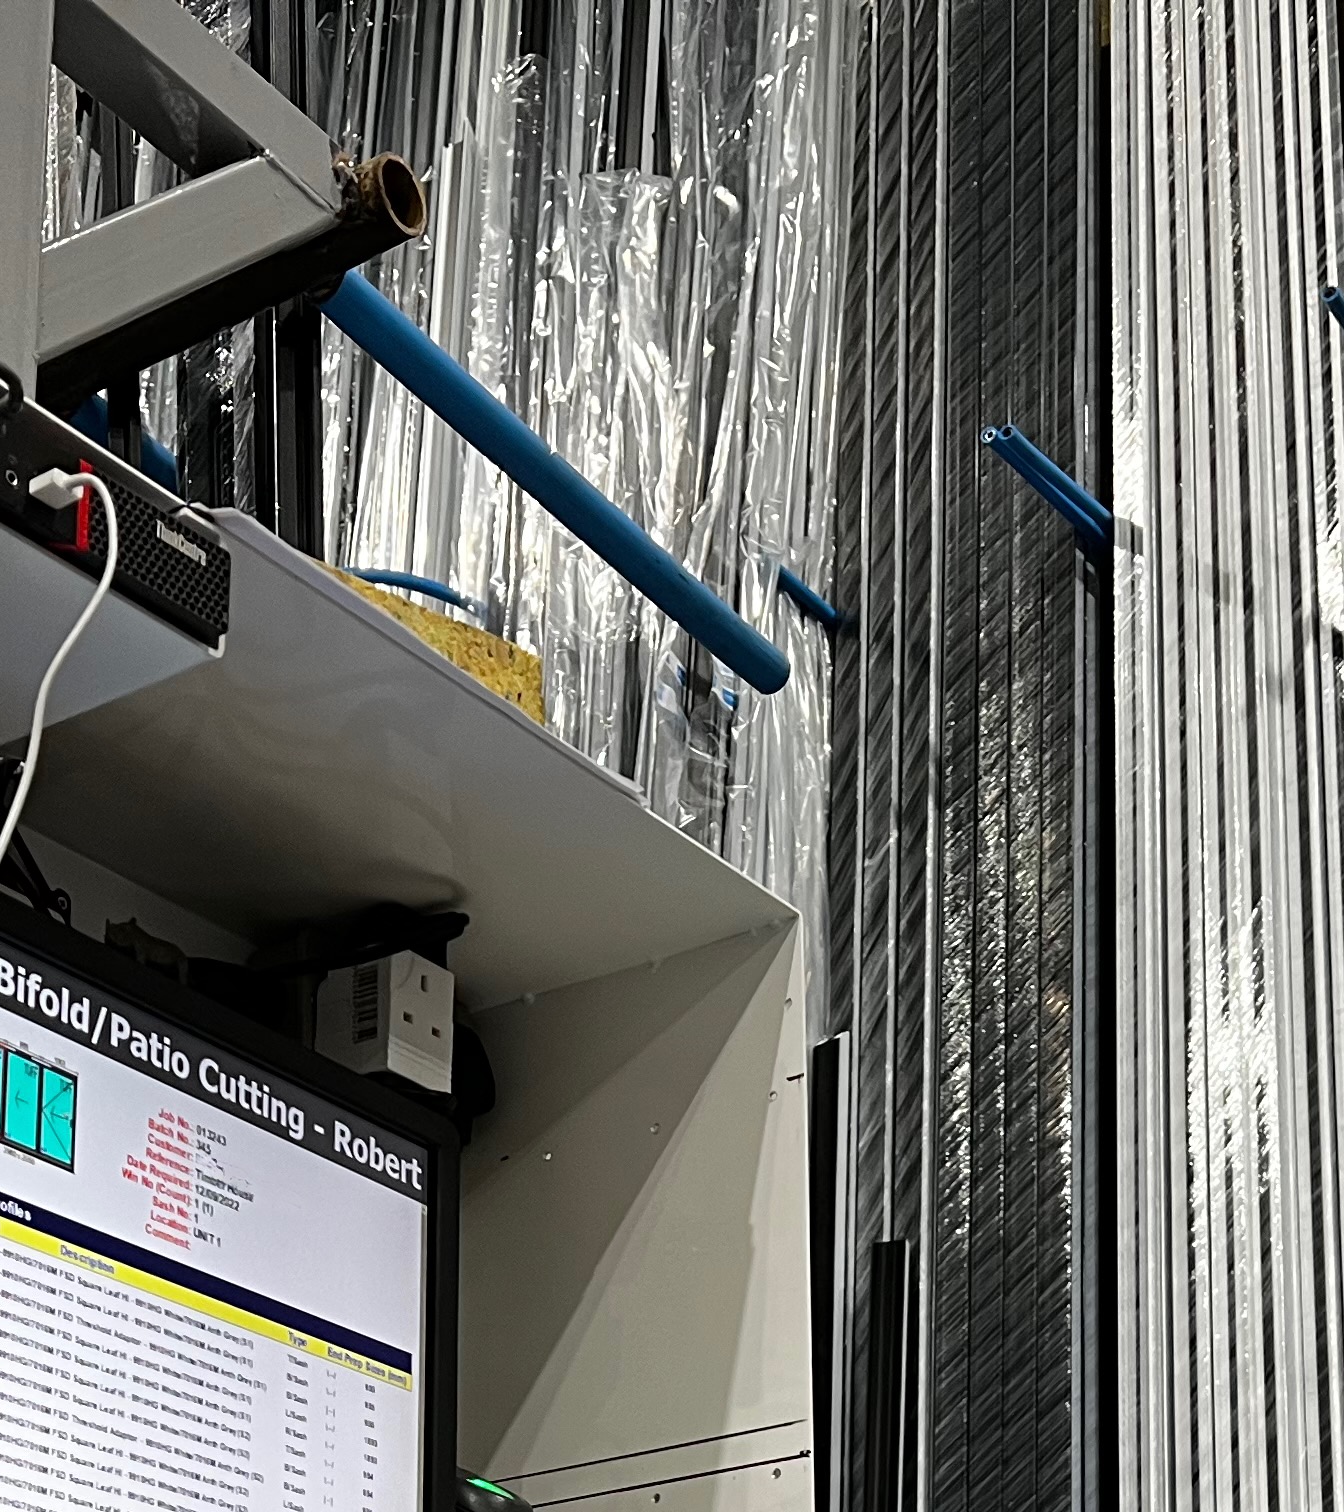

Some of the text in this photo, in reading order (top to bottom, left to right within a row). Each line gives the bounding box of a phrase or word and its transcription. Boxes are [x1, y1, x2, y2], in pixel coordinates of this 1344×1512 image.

[158, 1108, 174, 1123] Job
[197, 1057, 305, 1139] Cutting
[313, 1123, 325, 1137] -
[334, 1125, 422, 1191] Robert
[148, 1118, 174, 1138] Batch
[126, 1154, 147, 1171] Date
